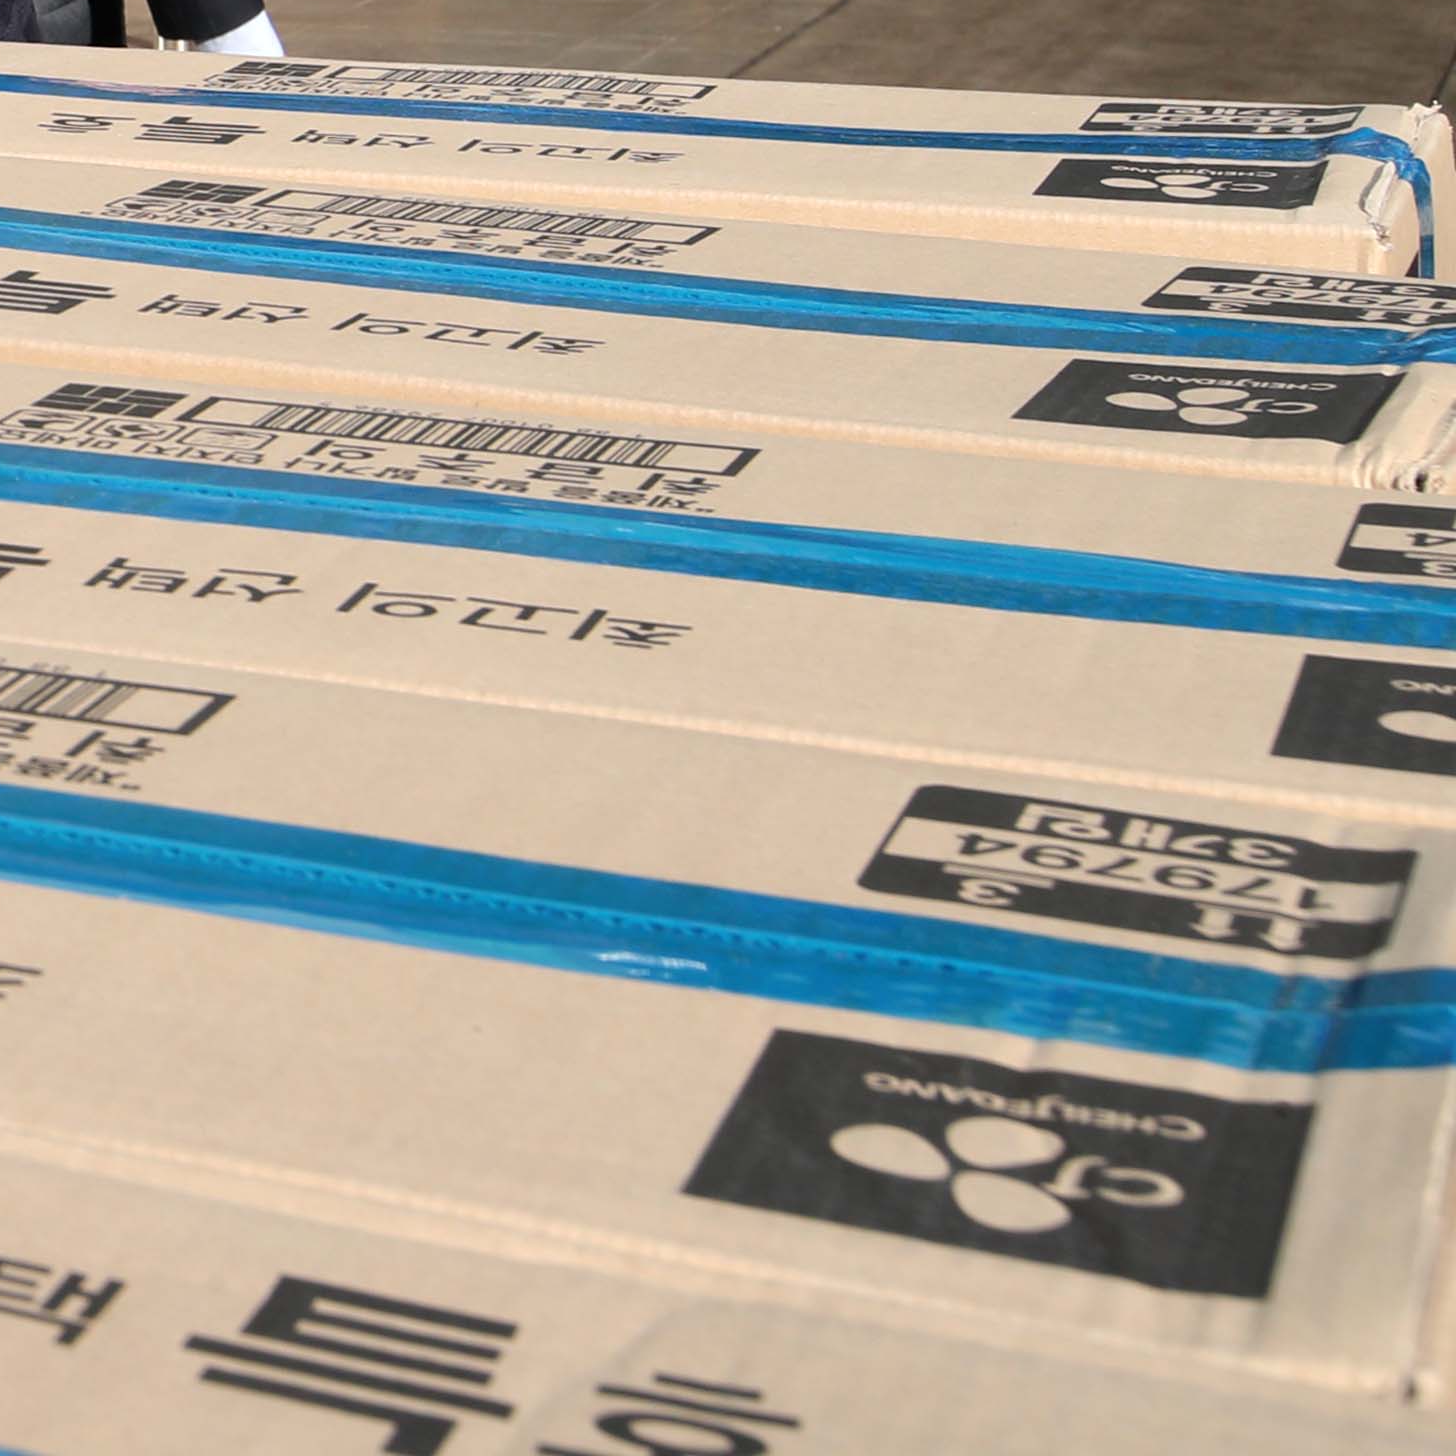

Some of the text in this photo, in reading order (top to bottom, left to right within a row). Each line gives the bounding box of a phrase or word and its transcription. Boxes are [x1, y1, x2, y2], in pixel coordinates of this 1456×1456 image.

[39, 111, 688, 164] 최고의 선택 특호
[138, 293, 312, 324] 선택
[332, 312, 606, 357] 최고의
[1127, 371, 1339, 393] CHEILJEDANG
[83, 556, 305, 605] 선택
[334, 582, 694, 649] 최고의
[954, 831, 1338, 922] 179794
[957, 874, 1019, 907] 3
[1045, 1154, 1186, 1208] CJ
